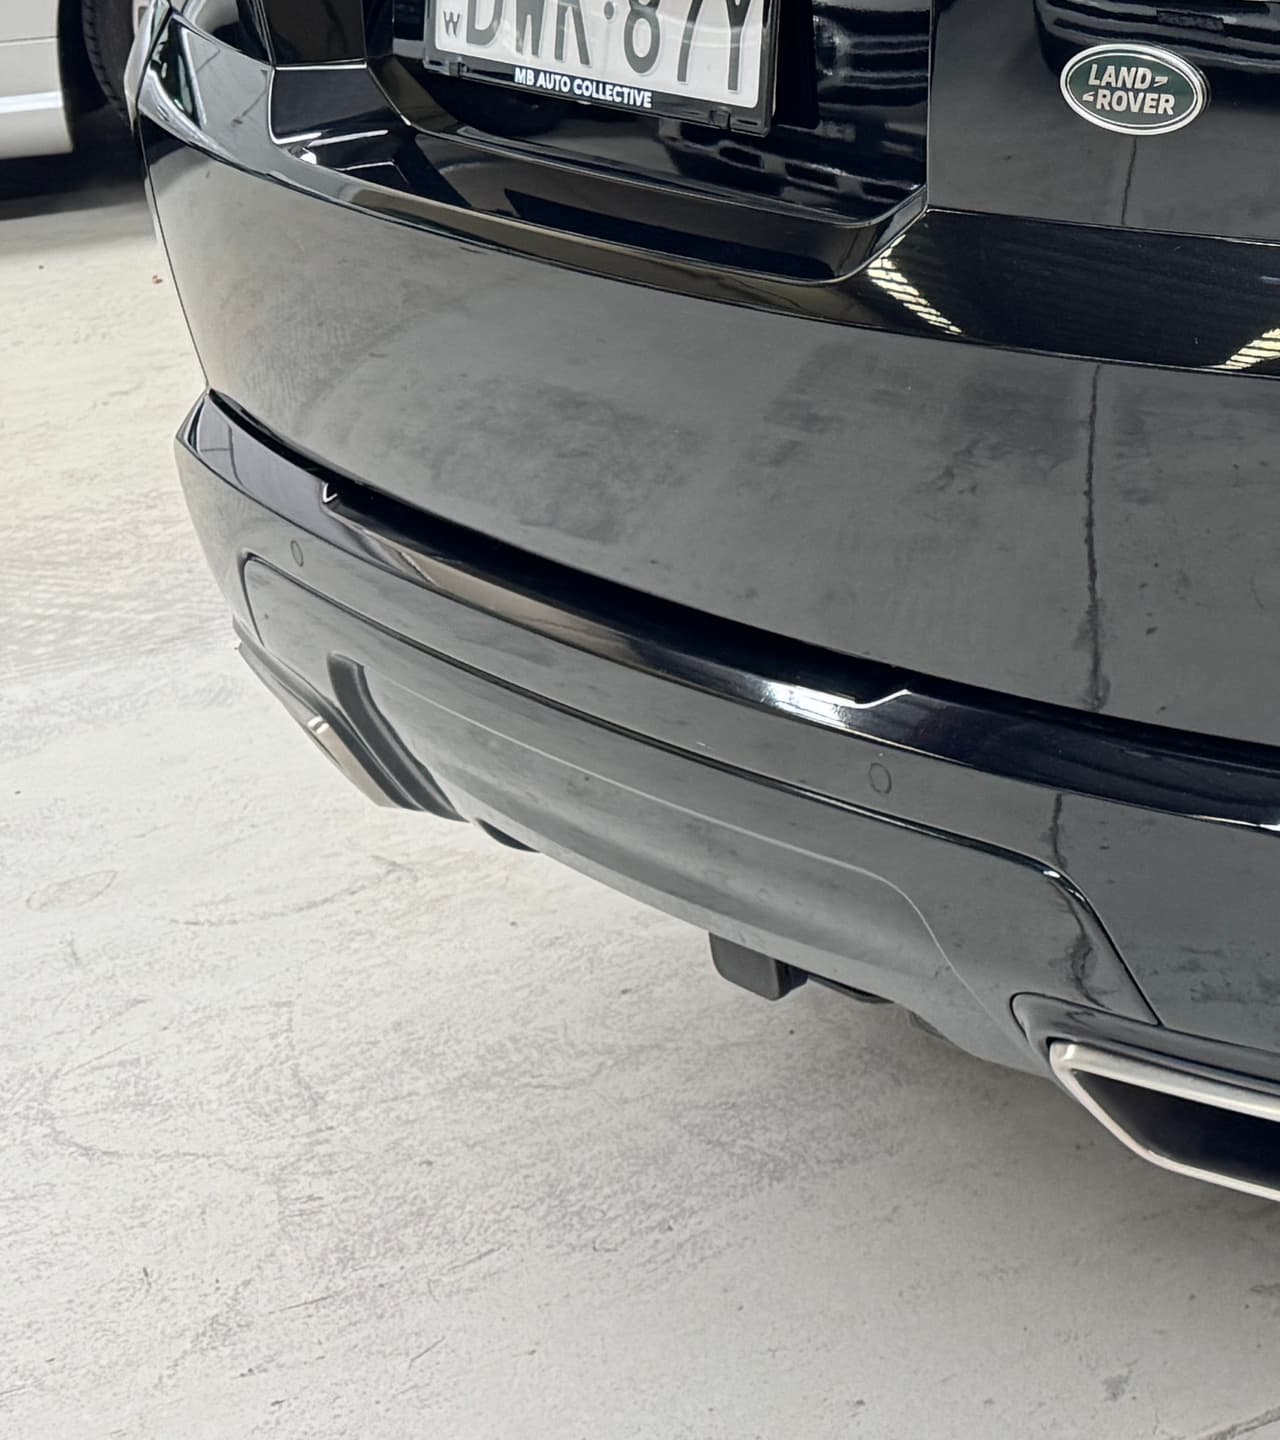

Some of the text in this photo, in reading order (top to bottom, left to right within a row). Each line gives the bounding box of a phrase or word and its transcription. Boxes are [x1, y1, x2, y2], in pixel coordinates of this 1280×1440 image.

[514, 66, 653, 109] MB AUTO COLLECTIVE
[1088, 63, 1153, 89] LAND
[1096, 89, 1176, 115] ROVER
